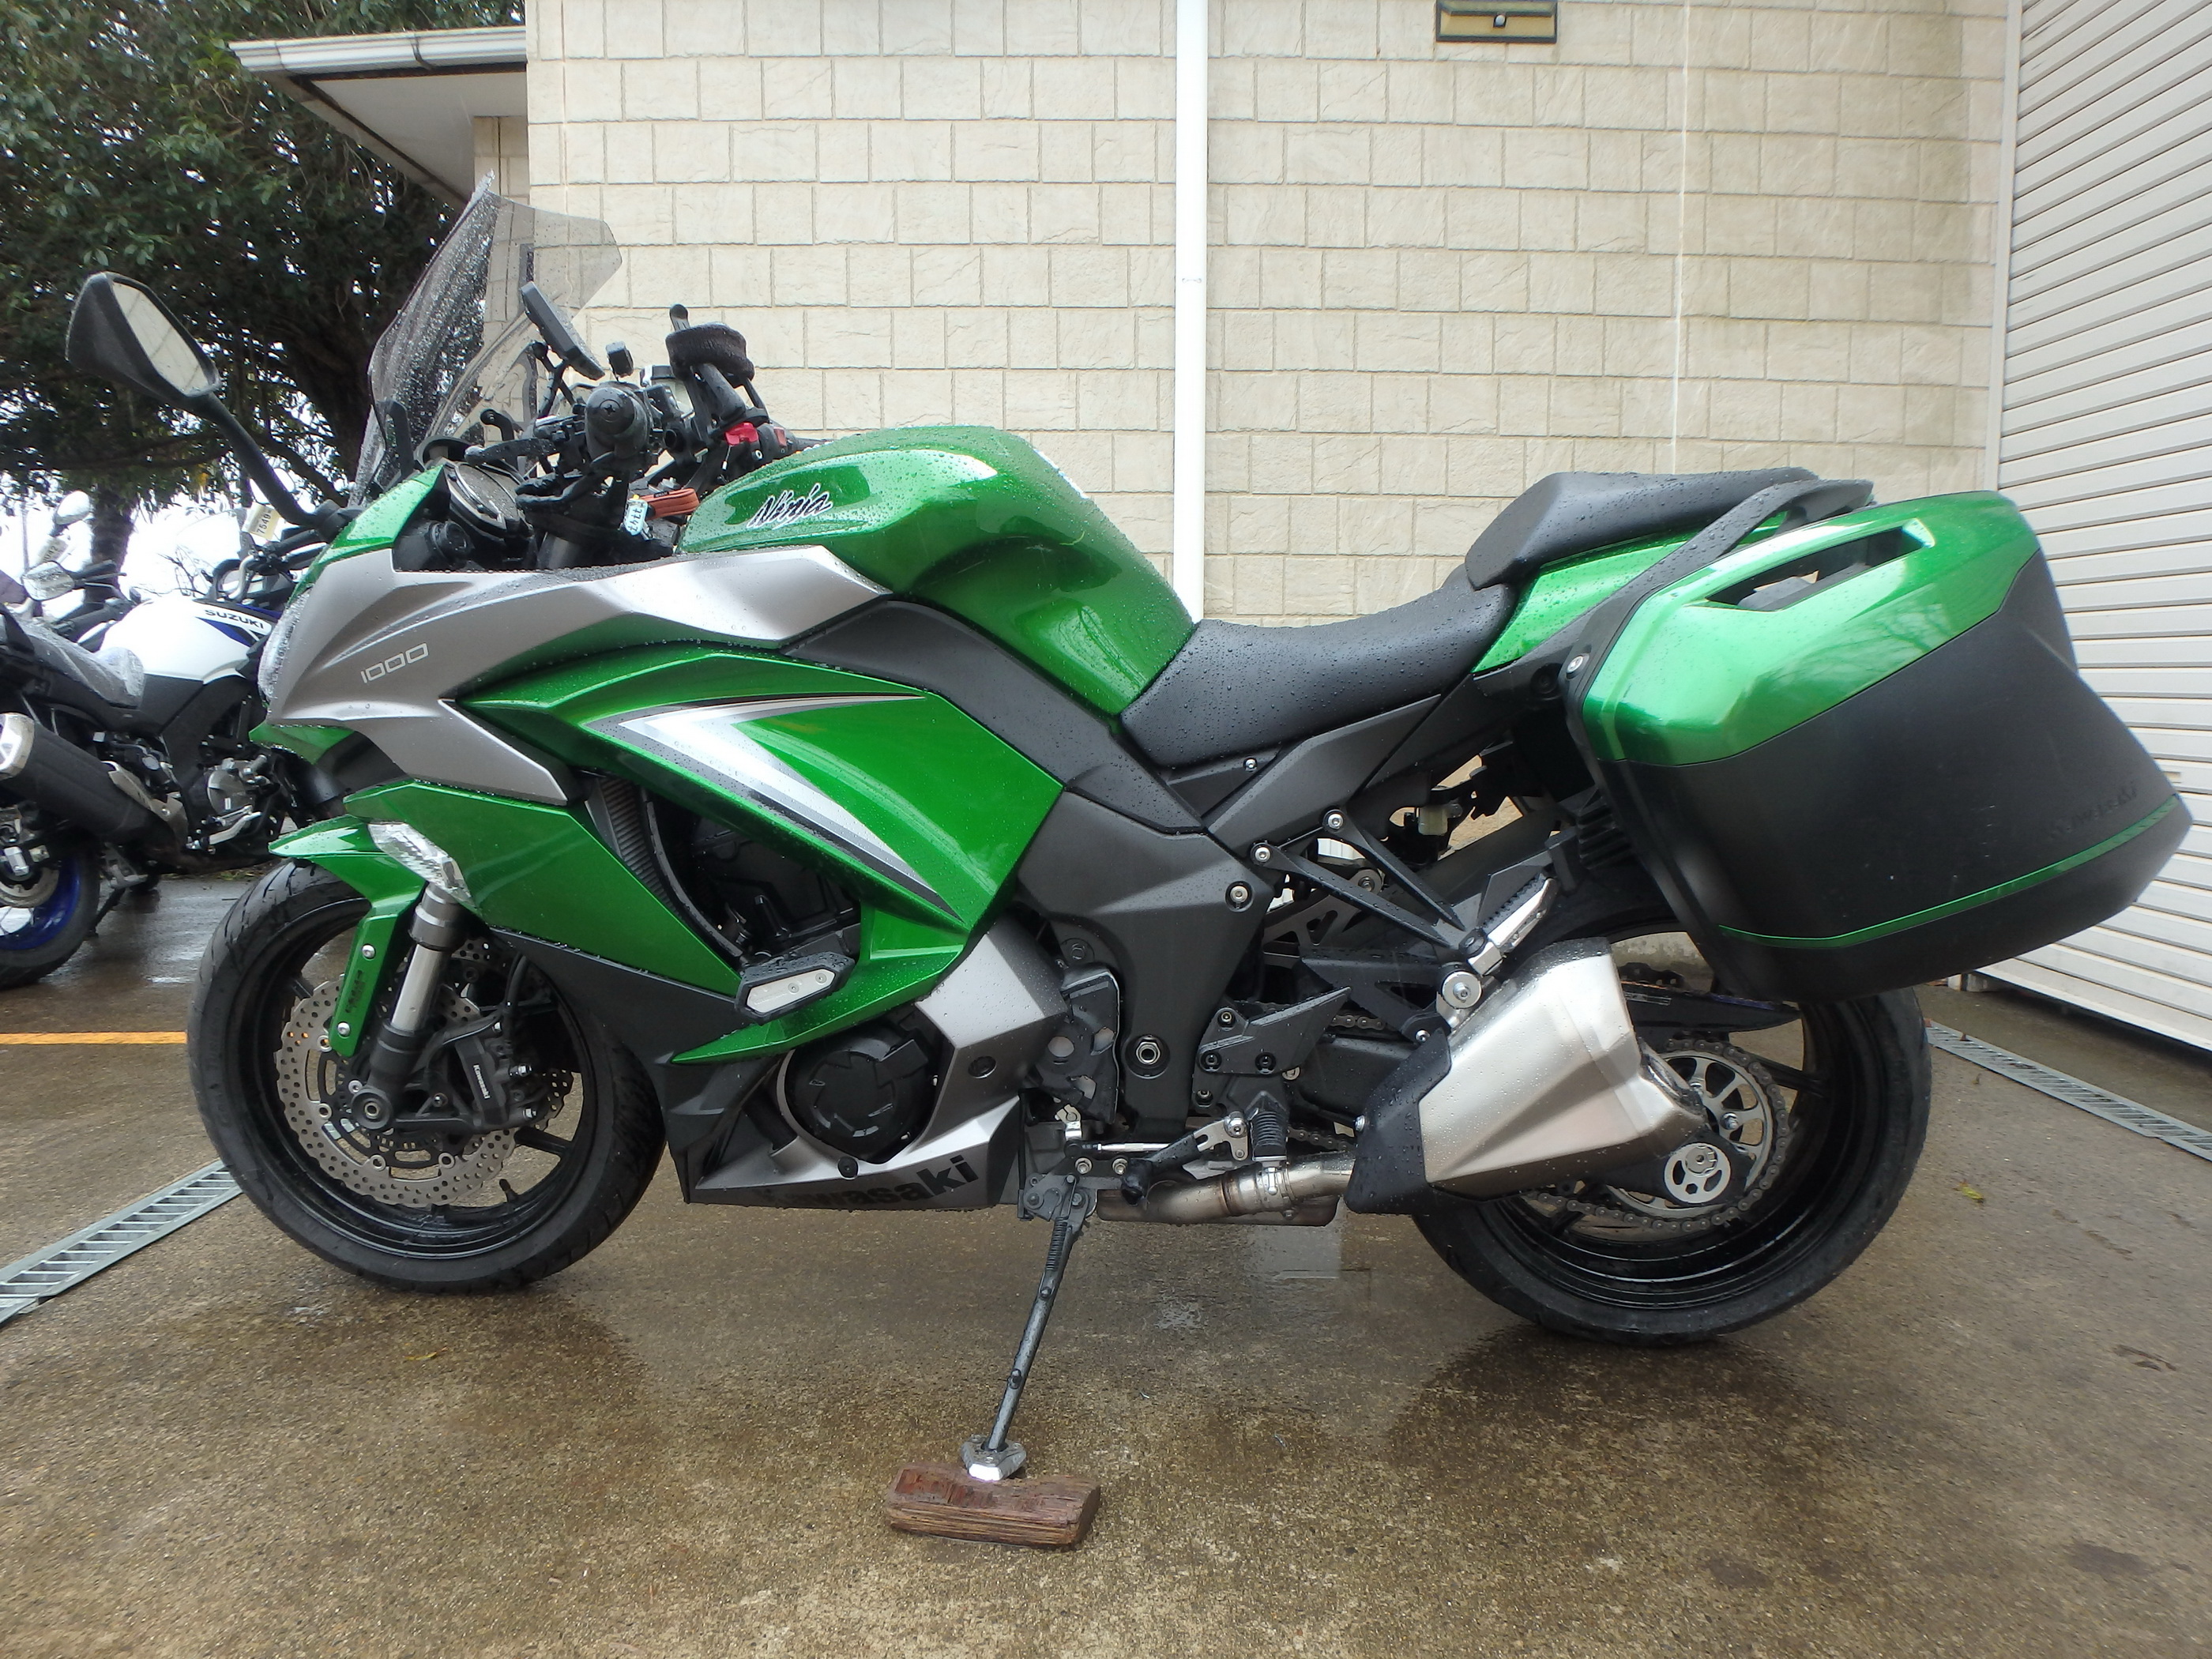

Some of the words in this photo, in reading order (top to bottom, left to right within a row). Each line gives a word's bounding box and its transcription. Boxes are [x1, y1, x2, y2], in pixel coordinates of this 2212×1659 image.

[256, 514, 272, 534] 7549
[746, 483, 833, 530] Ninja
[205, 609, 264, 629] SUZUKI
[360, 642, 429, 683] 1000
[472, 1064, 491, 1099] Kawasaki
